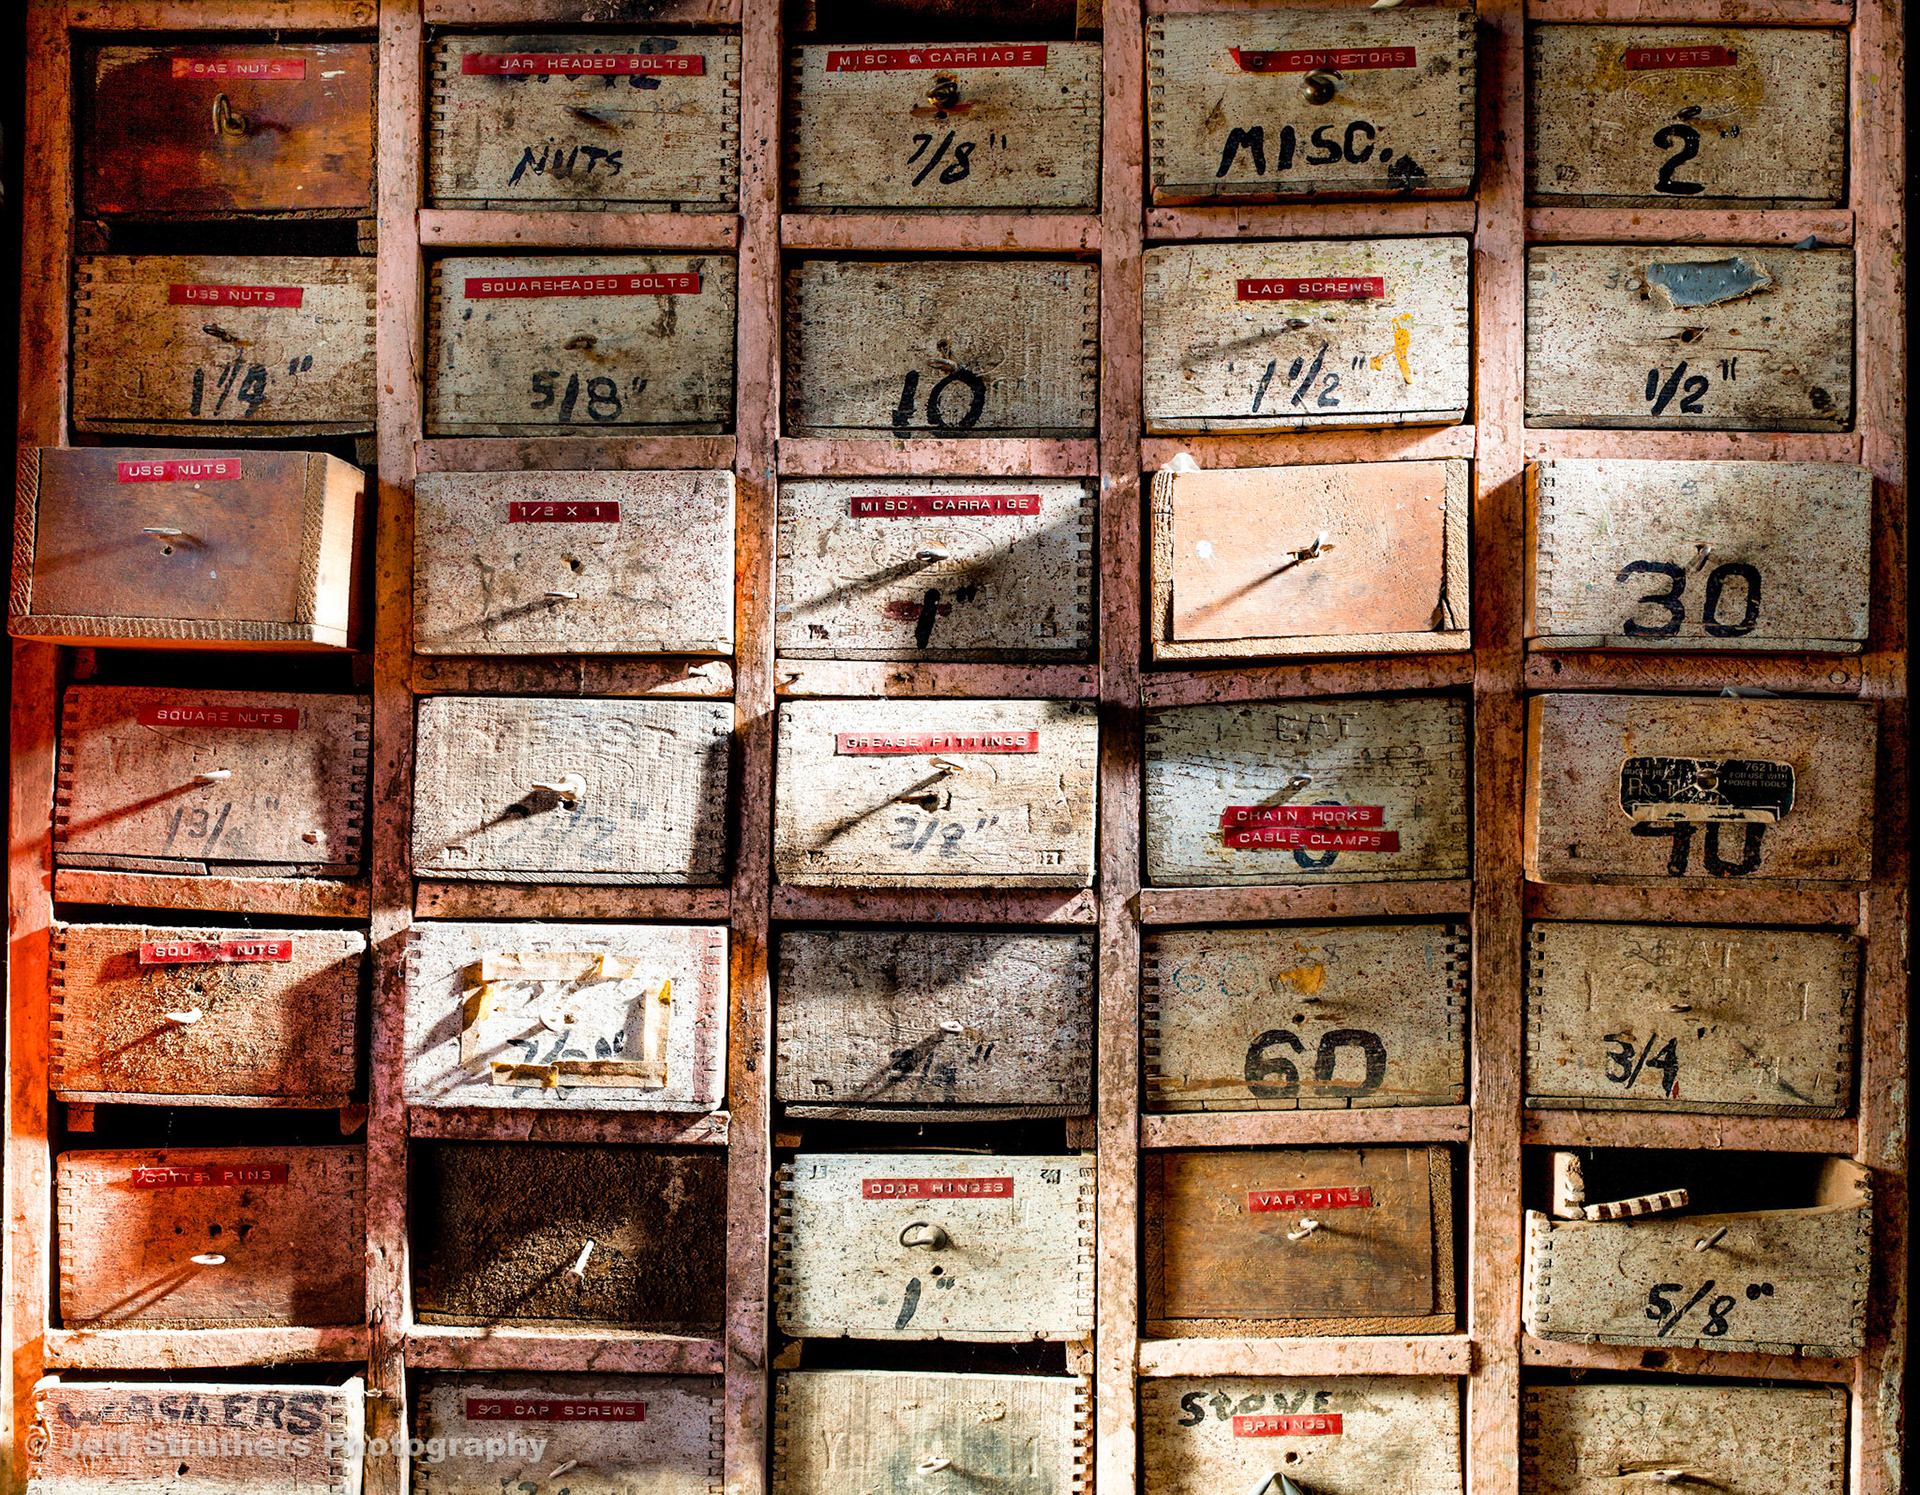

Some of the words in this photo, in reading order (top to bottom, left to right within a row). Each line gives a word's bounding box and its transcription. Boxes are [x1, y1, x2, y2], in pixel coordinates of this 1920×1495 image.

[839, 53, 898, 66] MISC.
[930, 51, 1033, 64] CARRIAGE
[1290, 52, 1406, 66] CONNECTORS
[1640, 50, 1711, 63] RIVETS
[194, 63, 227, 73] SAE
[237, 63, 281, 74] NUTS
[500, 58, 534, 69] JAR
[548, 58, 616, 69] HEADED
[629, 59, 689, 69] BOLTS
[1216, 120, 1394, 178] MISC.
[508, 145, 623, 188] NUTS
[481, 278, 619, 292] SQUAREHEADED
[630, 277, 691, 289] BOLTS
[1247, 283, 1285, 295] LAG
[1298, 281, 1374, 293] SCREWS
[186, 289, 219, 299] USS
[229, 290, 276, 301] NUTS
[129, 466, 164, 477] USS
[178, 463, 227, 475] NUTS
[521, 506, 554, 517] 1/2
[860, 500, 918, 512] MISC.
[932, 498, 1029, 511] CARRAIGE
[1616, 559, 1763, 638] 30
[157, 709, 230, 722] SQUARE
[238, 712, 283, 724] NUTS
[847, 736, 920, 748] GREASE
[1237, 811, 1298, 821] CHAIN
[1312, 810, 1370, 822] HOOKS
[1239, 833, 1300, 844] CABLE
[1310, 834, 1381, 847] CLAMPS
[237, 943, 279, 955] NUTS
[1245, 1028, 1387, 1099] 60
[224, 1170, 271, 1181] PINS
[871, 1182, 920, 1195] DOOR
[932, 1182, 1005, 1194] HINGES
[514, 1405, 549, 1416] CAP
[564, 1405, 636, 1416] SCREWS
[1243, 1419, 1327, 1432] SPRINGS
